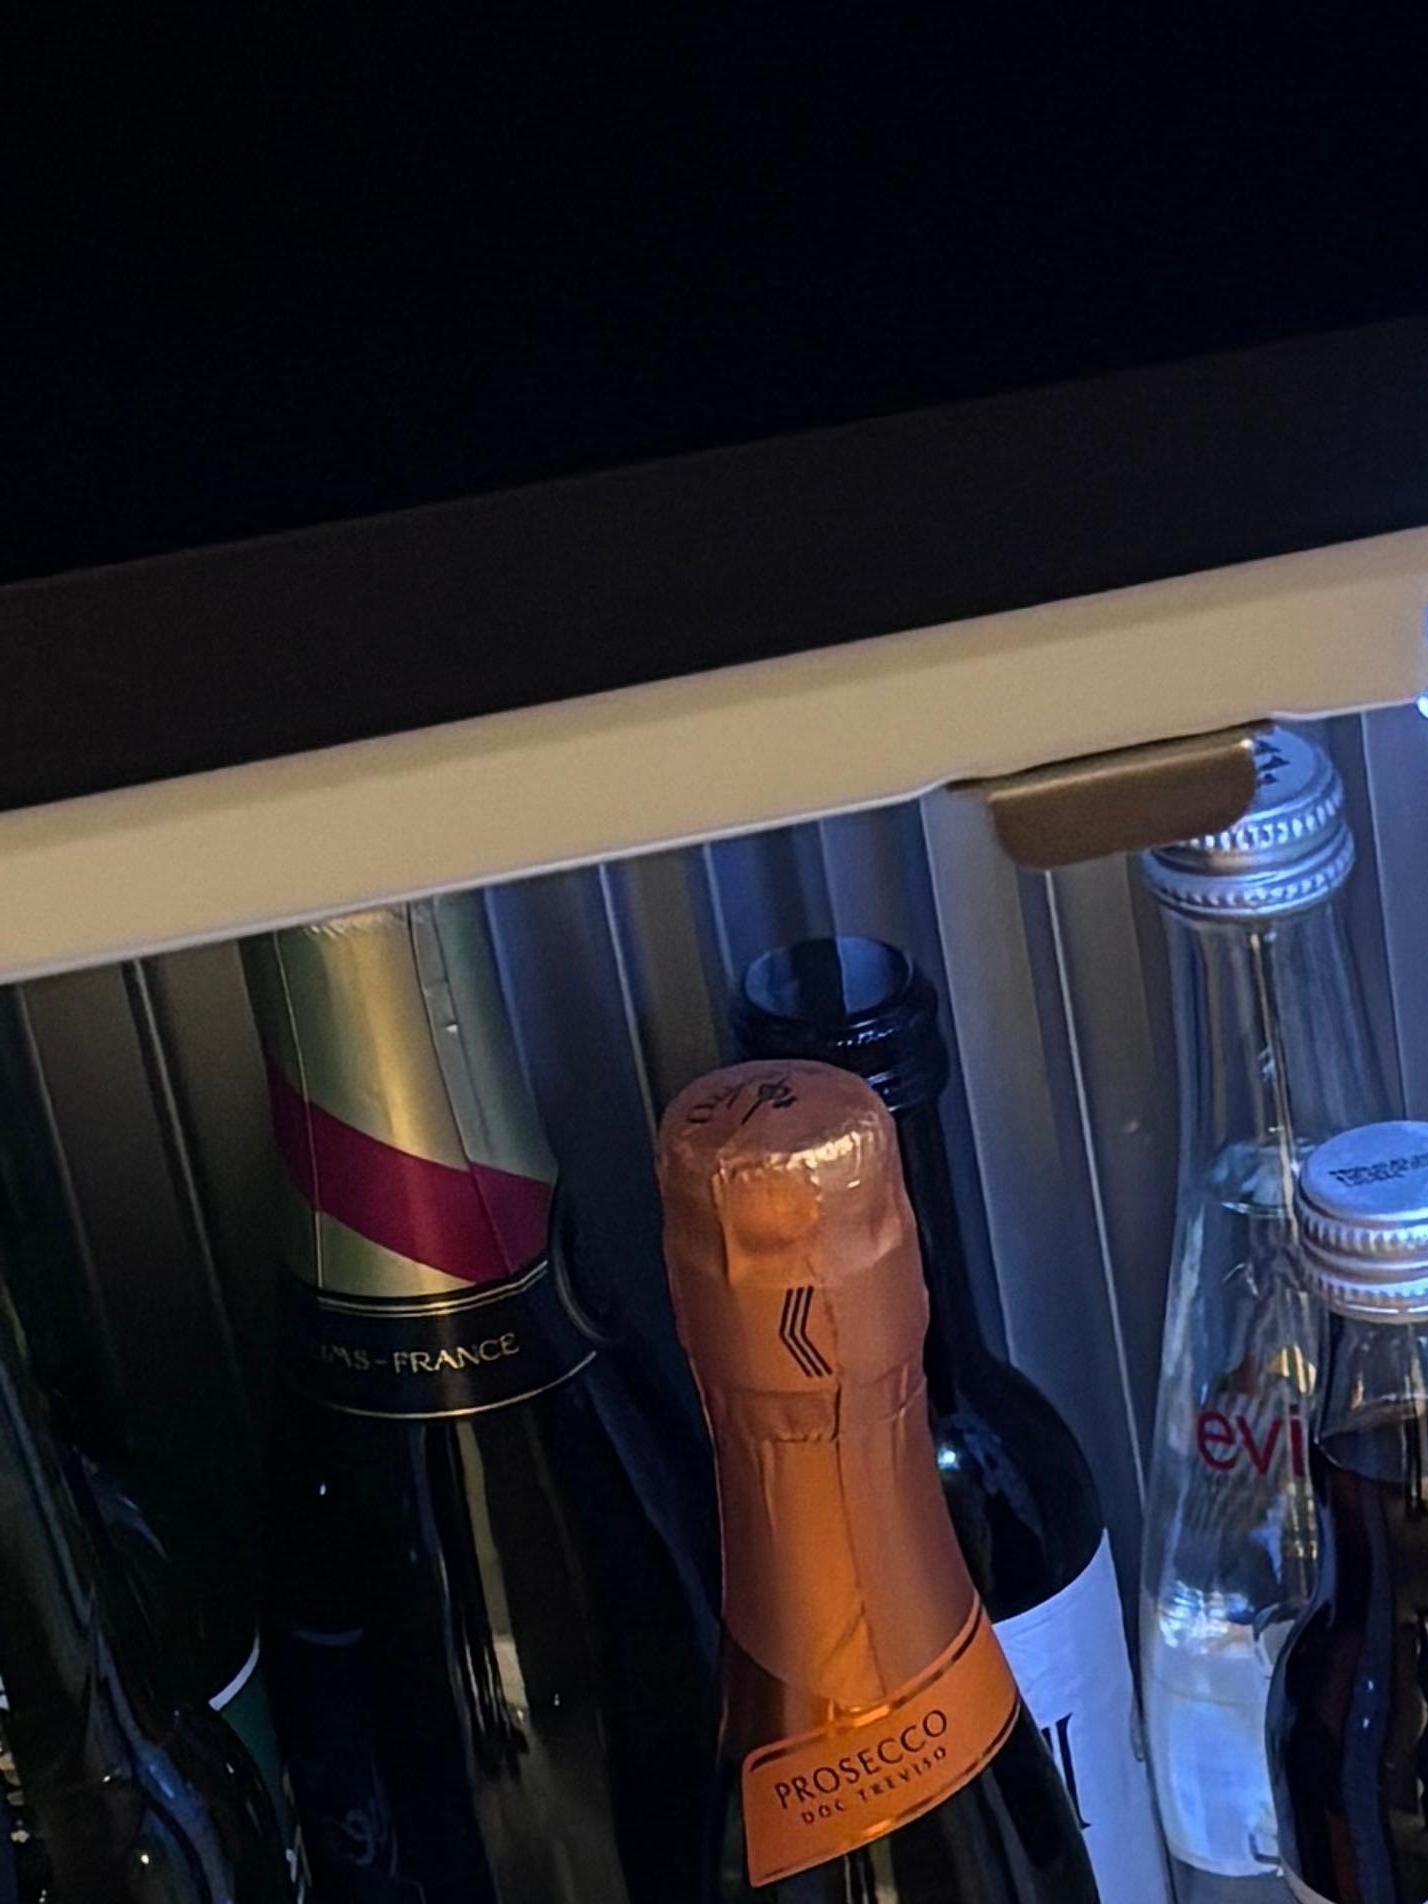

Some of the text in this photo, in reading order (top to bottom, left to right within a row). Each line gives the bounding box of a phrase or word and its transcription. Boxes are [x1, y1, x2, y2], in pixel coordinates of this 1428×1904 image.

[1195, 1403, 1305, 1478] evi
[773, 1709, 948, 1810] PROSECCO
[857, 1746, 947, 1802] TREVISO
